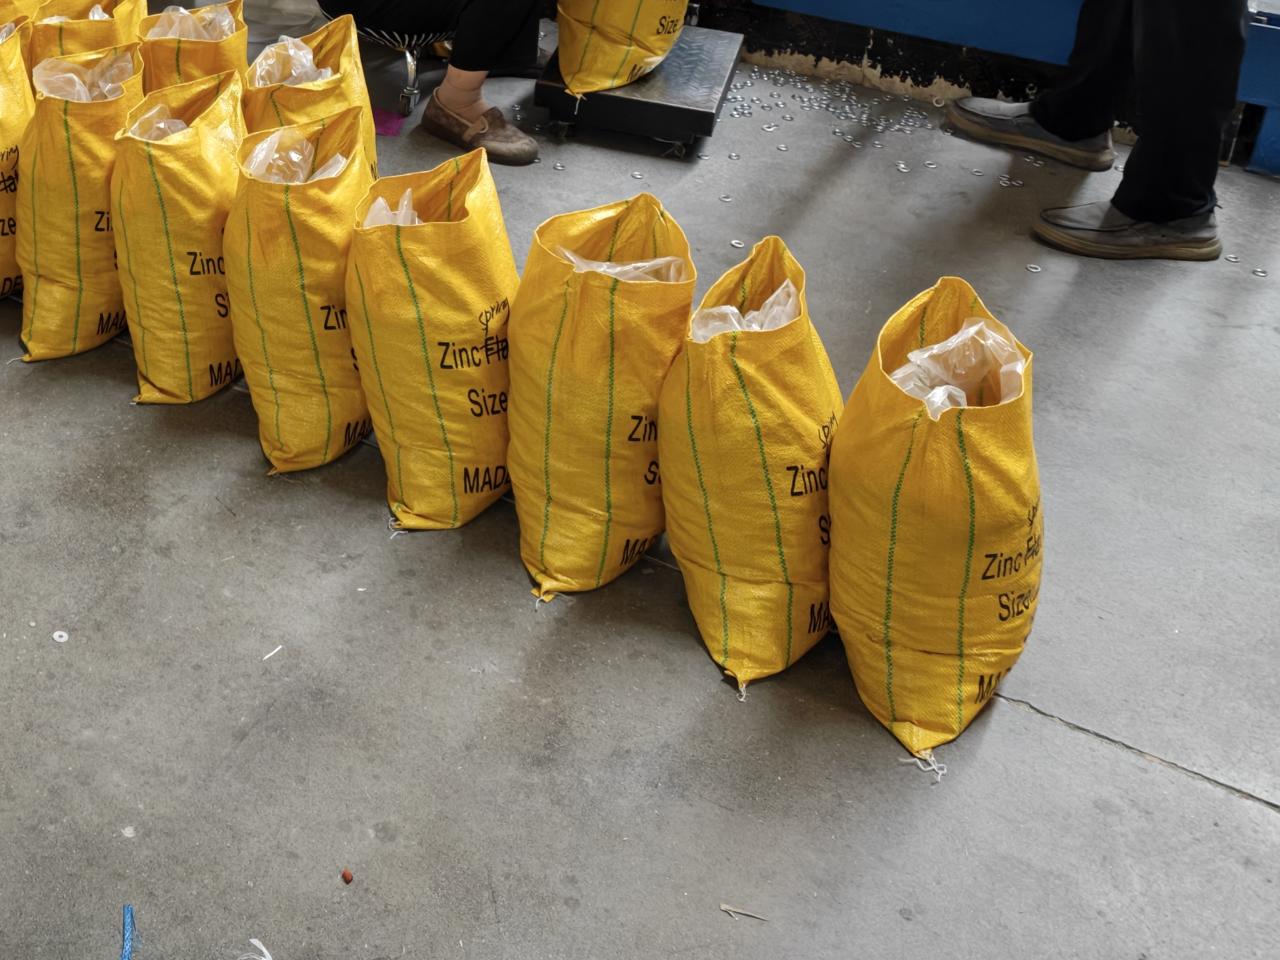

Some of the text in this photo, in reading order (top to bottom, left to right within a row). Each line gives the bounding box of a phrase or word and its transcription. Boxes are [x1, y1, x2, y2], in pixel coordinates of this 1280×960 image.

[94, 211, 113, 232] Zi
[437, 341, 481, 370] Zinc
[628, 415, 658, 443] Zin
[981, 551, 1024, 581] Zinc
